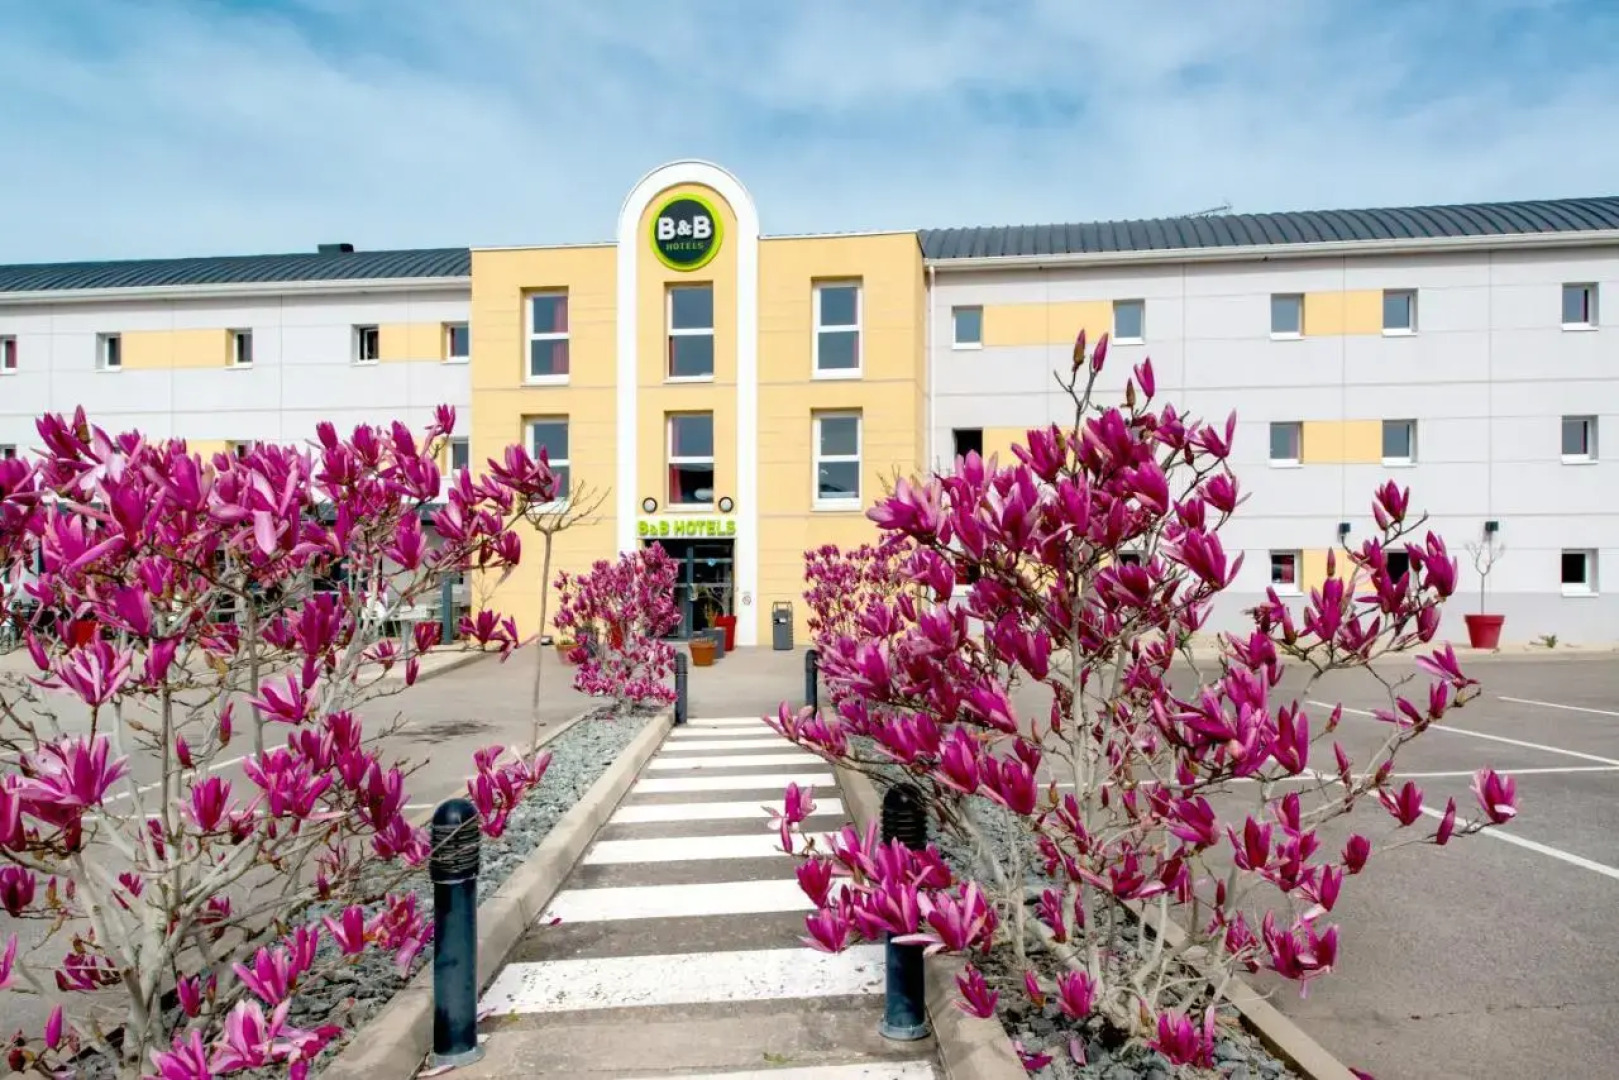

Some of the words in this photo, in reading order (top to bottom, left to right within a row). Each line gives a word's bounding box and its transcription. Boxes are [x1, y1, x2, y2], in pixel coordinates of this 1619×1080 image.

[658, 215, 712, 241] B&B
[666, 242, 705, 251] HOTELS
[637, 520, 670, 536] B&B
[674, 520, 736, 536] HOTELS
